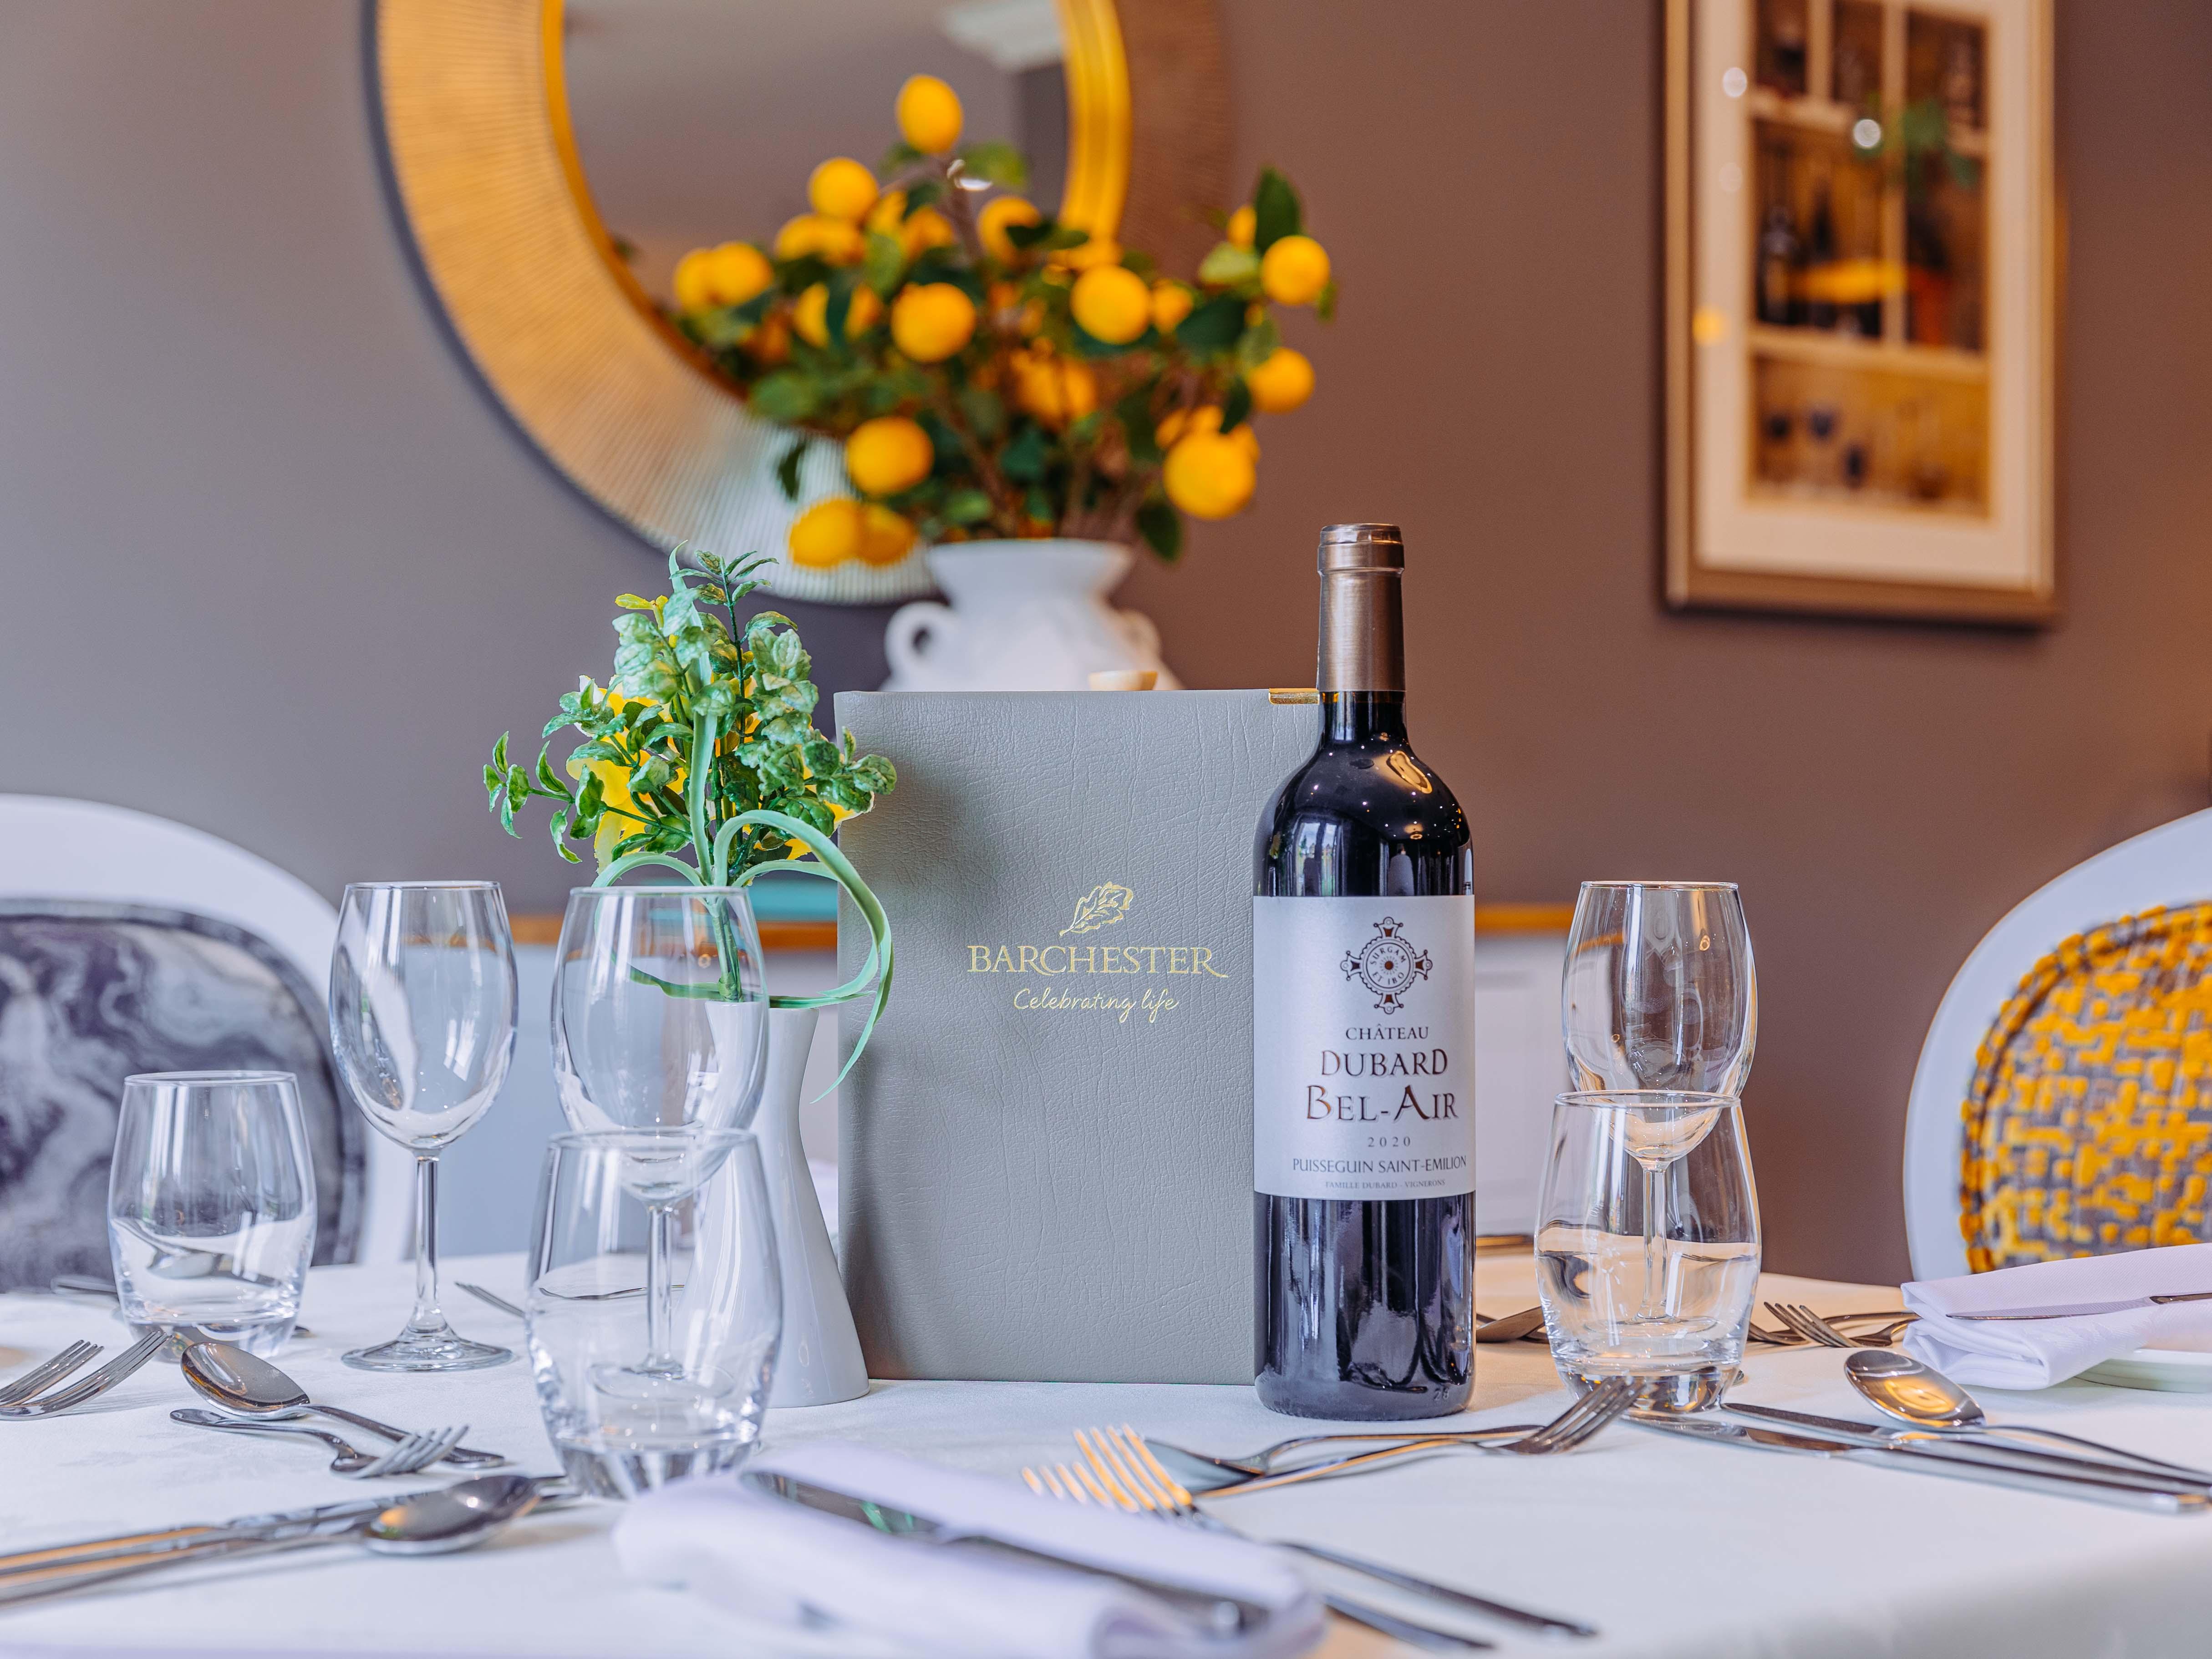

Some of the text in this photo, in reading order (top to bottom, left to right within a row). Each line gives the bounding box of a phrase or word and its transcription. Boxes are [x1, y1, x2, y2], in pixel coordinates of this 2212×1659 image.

[966, 945, 1228, 978] BARCHESTER
[1370, 947, 1406, 965] SURGAM
[1373, 972, 1383, 982] ET
[1013, 987, 1179, 1023] Celebrating life
[1345, 1023, 1429, 1040] CHÂTEAU
[1321, 1048, 1448, 1077] DUBARD
[1368, 1136, 1411, 1148] 2020
[1293, 1155, 1467, 1174] PUISSEGUIN SAINT-EMILION
[1405, 1179, 1446, 1188] VIGNERONS
